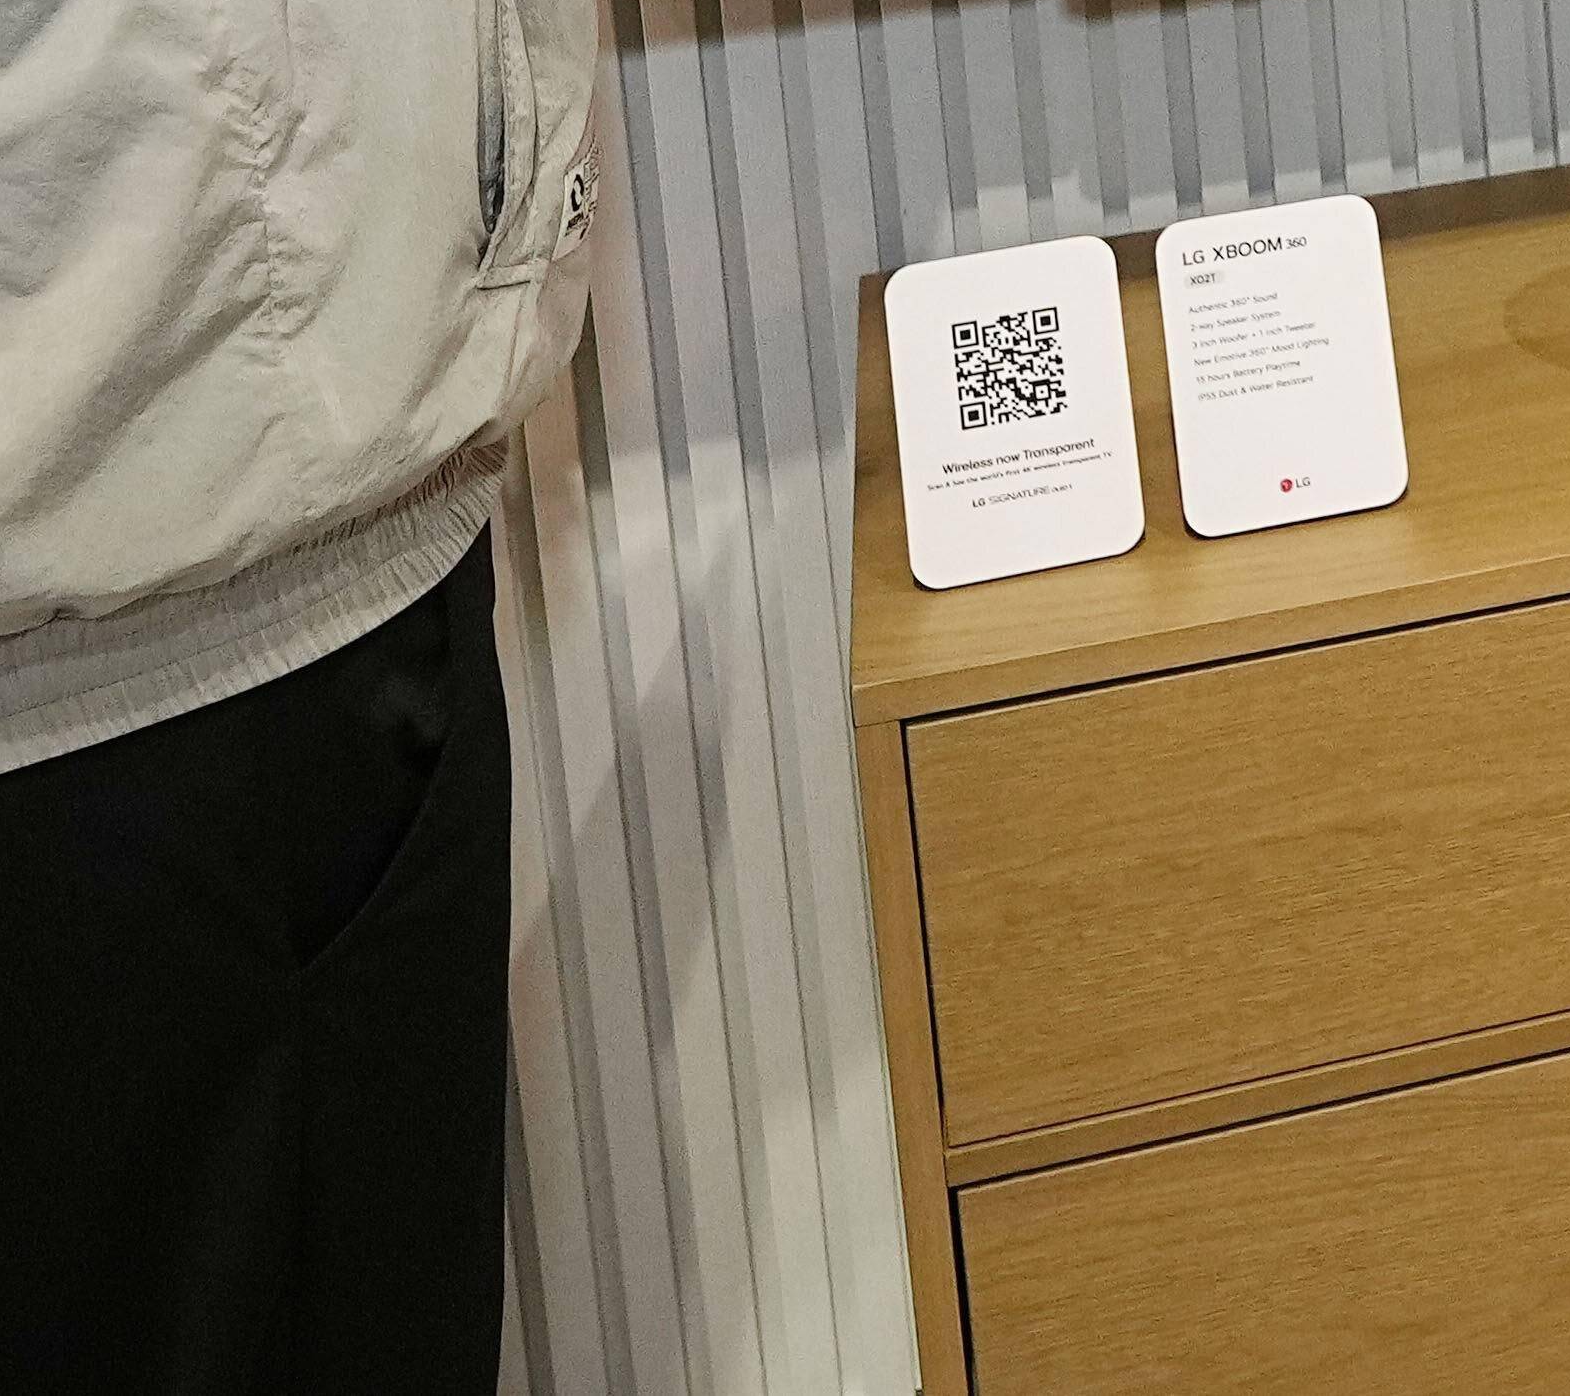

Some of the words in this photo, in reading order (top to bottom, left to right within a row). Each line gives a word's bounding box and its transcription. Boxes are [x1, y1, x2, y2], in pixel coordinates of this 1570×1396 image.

[1182, 250, 1205, 266] LG
[1212, 237, 1283, 261] XBOOM
[1286, 236, 1307, 249] 360
[942, 458, 993, 474] Wireless
[996, 454, 1020, 466] now
[1022, 438, 1095, 460] Transparent
[1295, 476, 1311, 488] LG
[972, 497, 986, 508] LG
